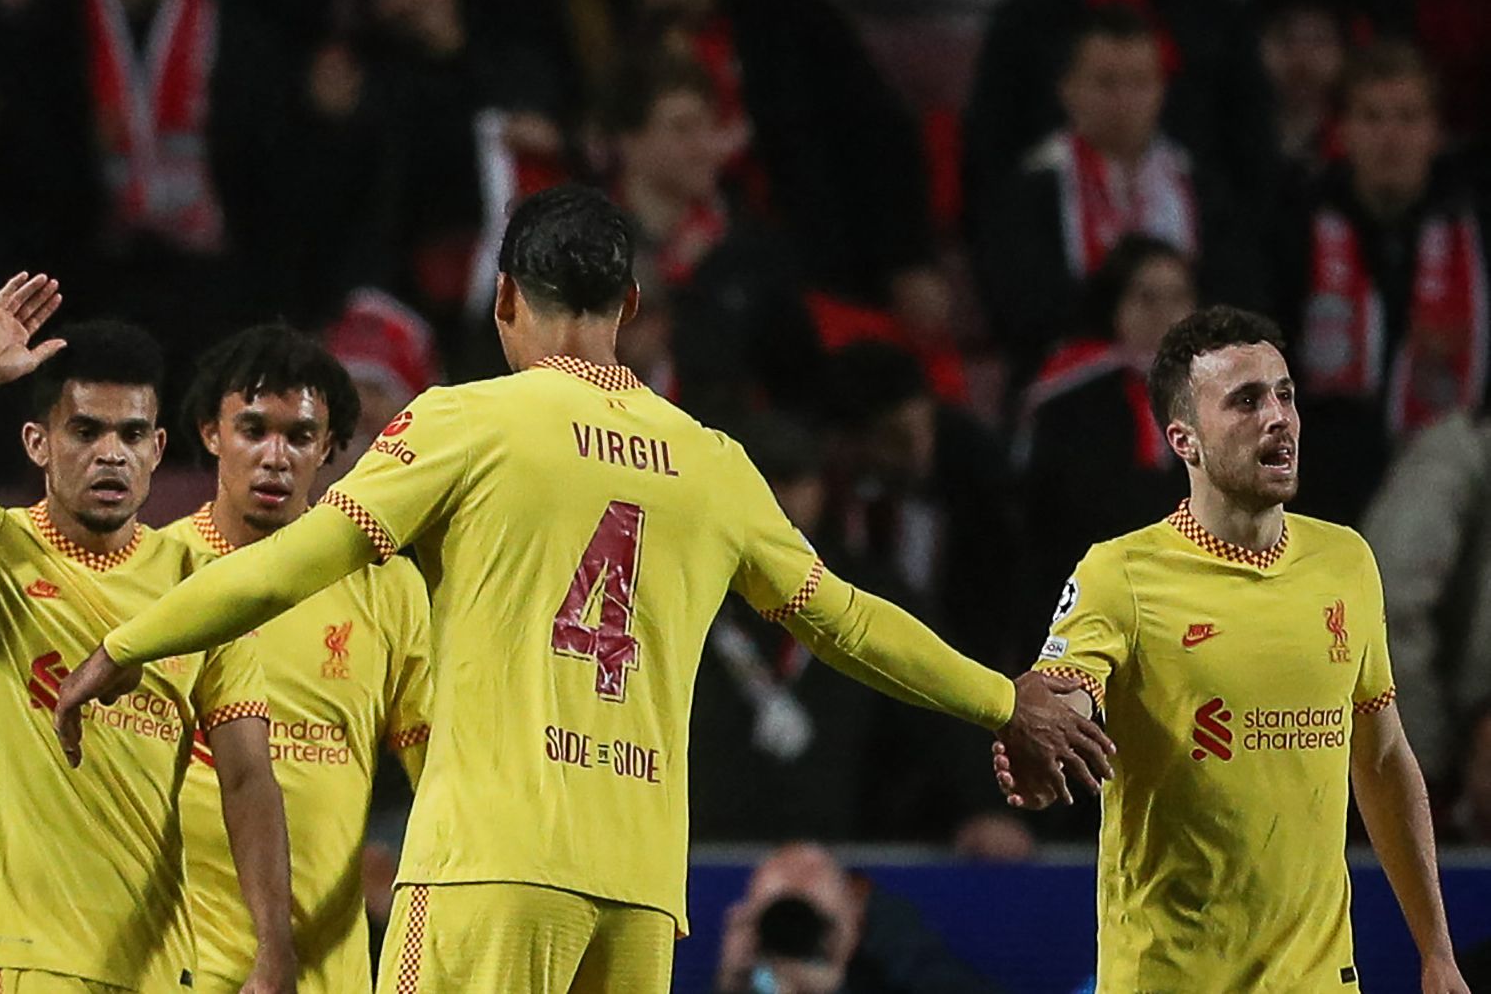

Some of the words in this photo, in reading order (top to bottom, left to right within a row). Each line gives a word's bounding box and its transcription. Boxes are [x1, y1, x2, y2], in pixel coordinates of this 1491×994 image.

[374, 438, 417, 465] edia
[572, 421, 679, 476] VIRGIL
[551, 501, 646, 703] 4
[1244, 706, 1344, 728] standard
[273, 719, 347, 742] ndard
[1244, 727, 1345, 751] chartered
[269, 743, 350, 764] artered
[545, 725, 593, 768] SIDE
[613, 739, 661, 784] SIDE
